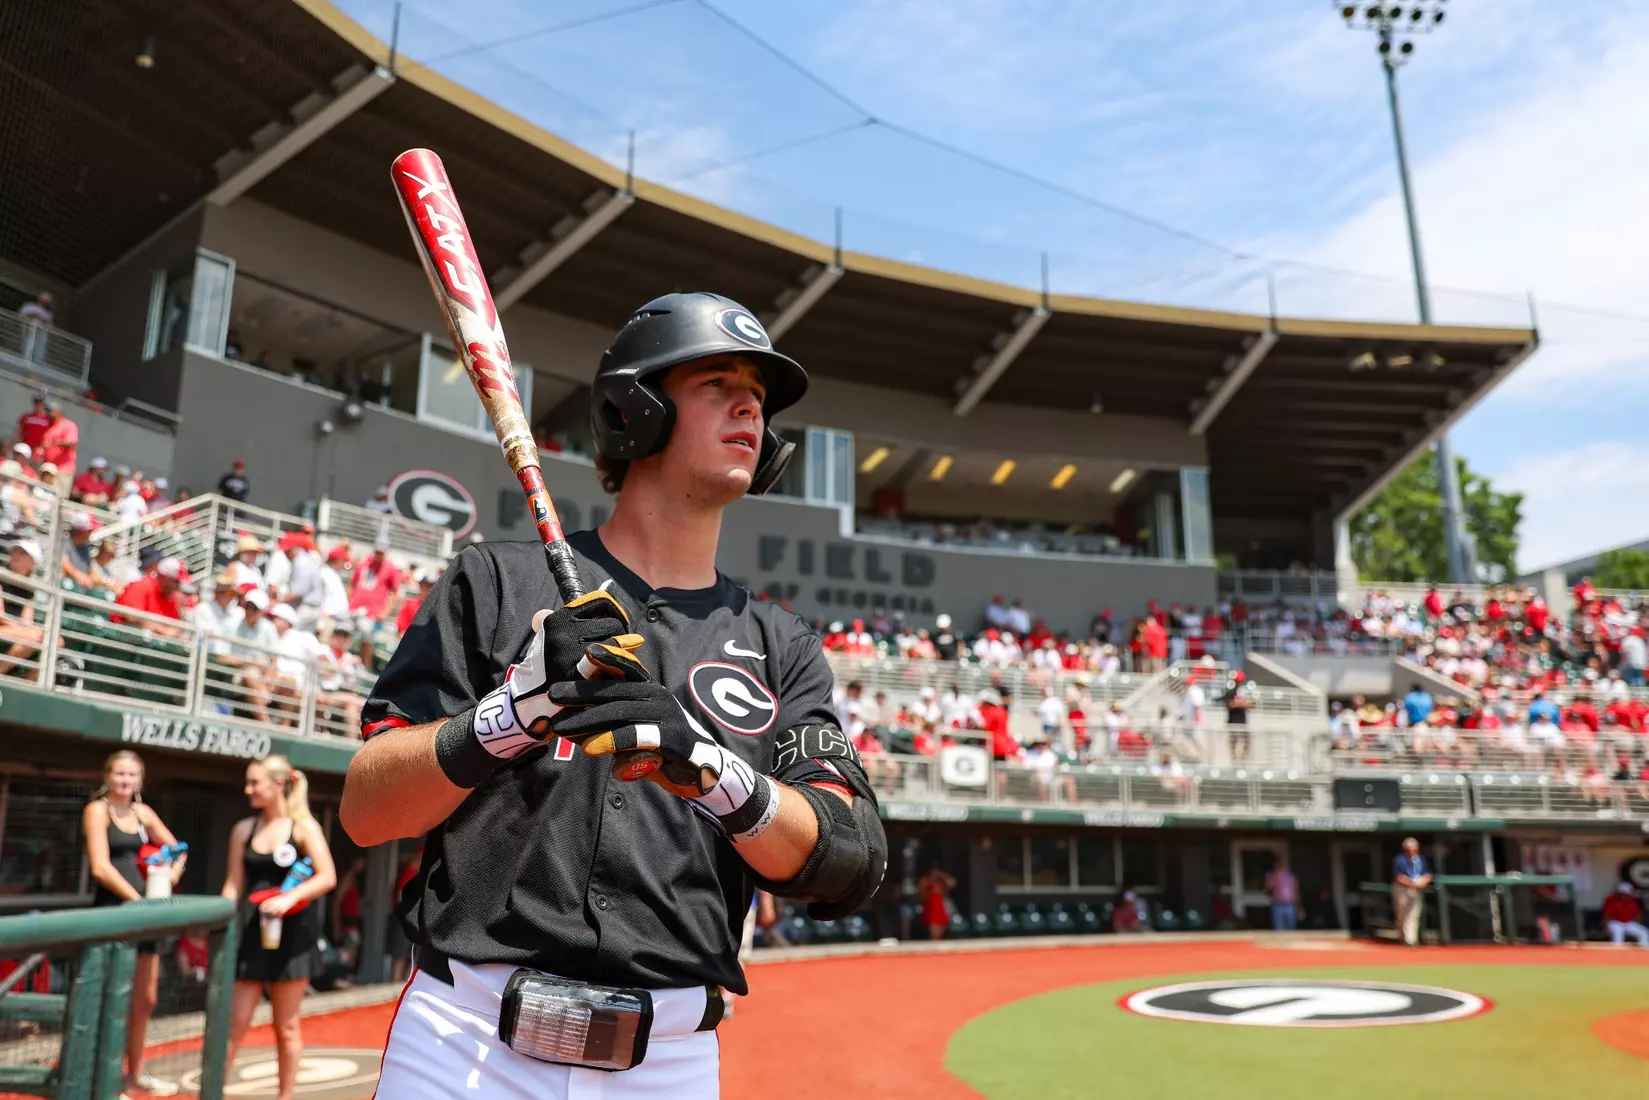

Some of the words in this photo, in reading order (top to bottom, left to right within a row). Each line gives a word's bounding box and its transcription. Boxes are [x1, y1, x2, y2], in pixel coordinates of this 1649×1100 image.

[759, 536, 936, 587] FIELD
[121, 712, 199, 750] WELLS
[202, 725, 271, 760] FARGO
